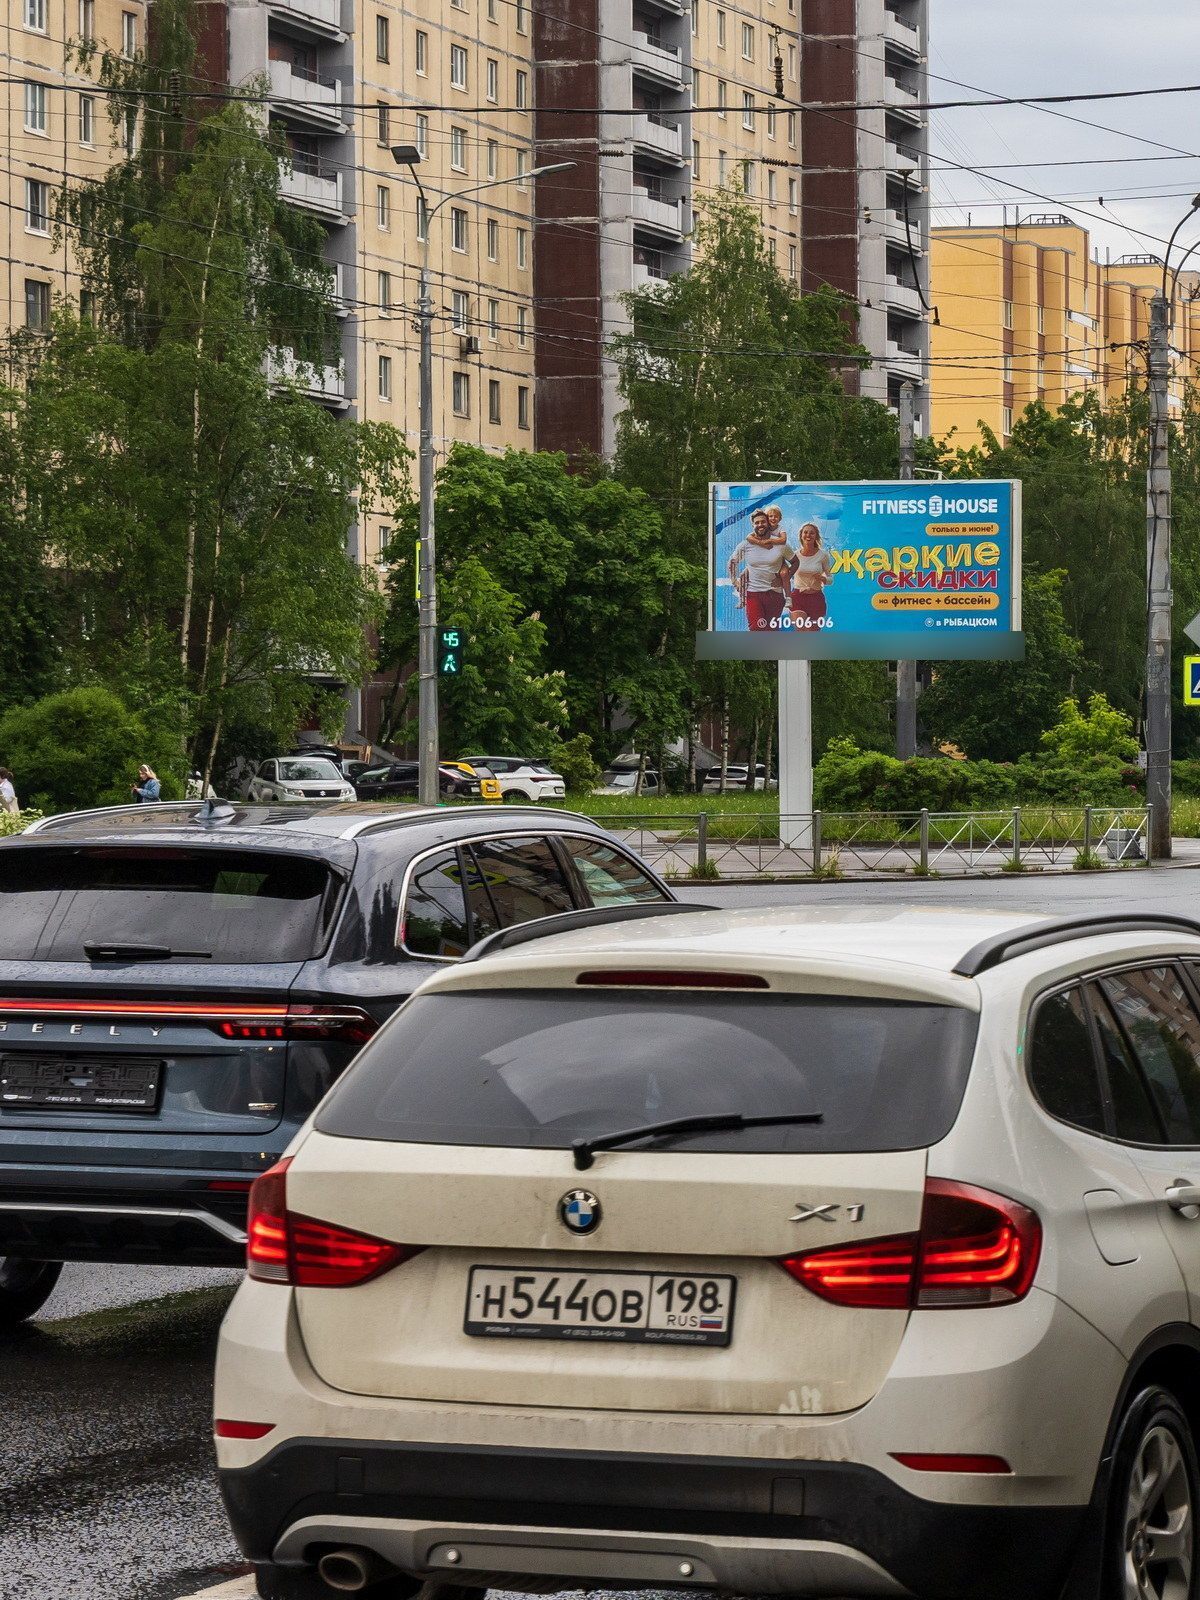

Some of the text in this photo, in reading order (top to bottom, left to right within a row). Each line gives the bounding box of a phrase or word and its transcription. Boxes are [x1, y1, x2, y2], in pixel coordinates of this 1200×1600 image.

[862, 498, 998, 514] FITNESS HOUSE
[968, 524, 994, 532] июне!
[830, 541, 1000, 577] жаркие
[892, 596, 932, 607] фитнес
[944, 595, 991, 605] бассейн
[769, 616, 834, 628] 610-06-06
[943, 617, 998, 627] РЫБАЦКОМ
[443, 632, 459, 647] 45
[788, 1202, 865, 1222] X1
[482, 1276, 719, 1324] Н544ОВ 198
[667, 1315, 698, 1328] RUS
